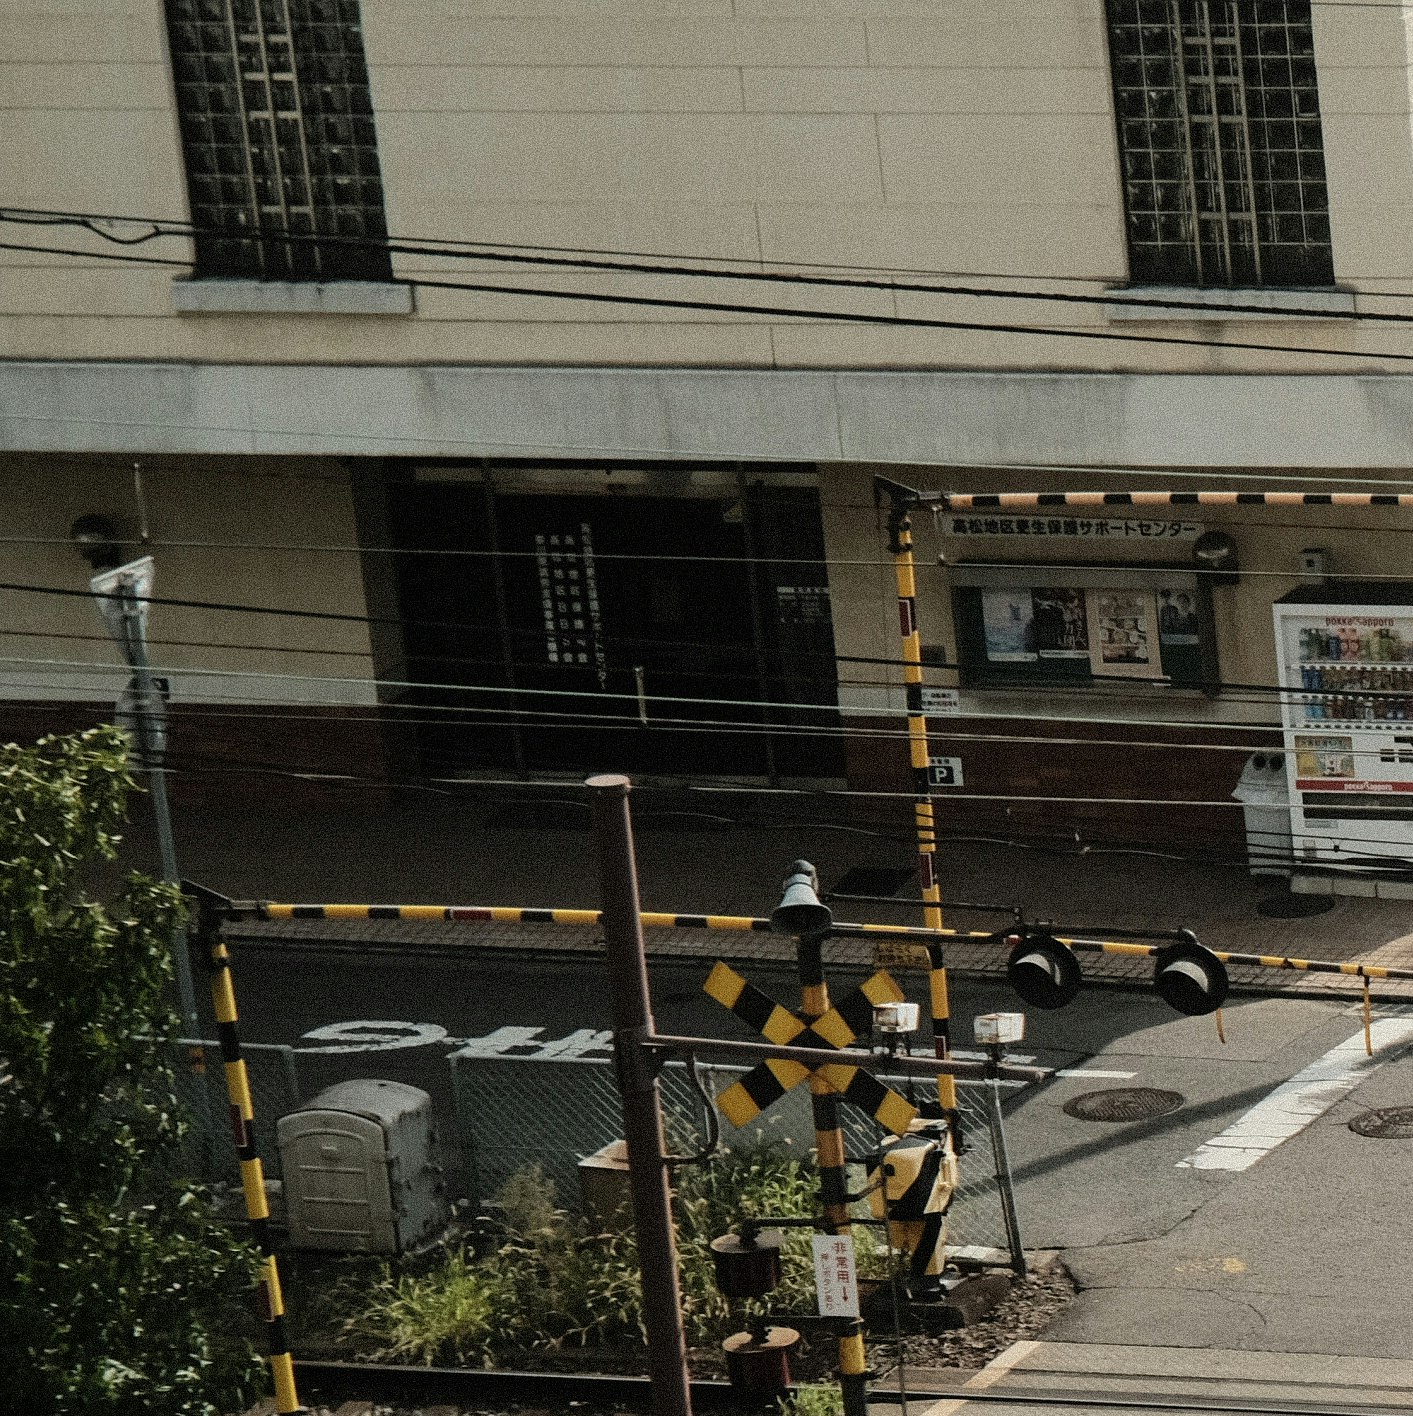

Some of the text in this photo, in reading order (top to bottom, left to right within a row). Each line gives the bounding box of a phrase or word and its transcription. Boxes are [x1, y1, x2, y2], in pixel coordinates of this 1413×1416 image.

[935, 767, 947, 783] P
[832, 1242, 850, 1284] 非常用
